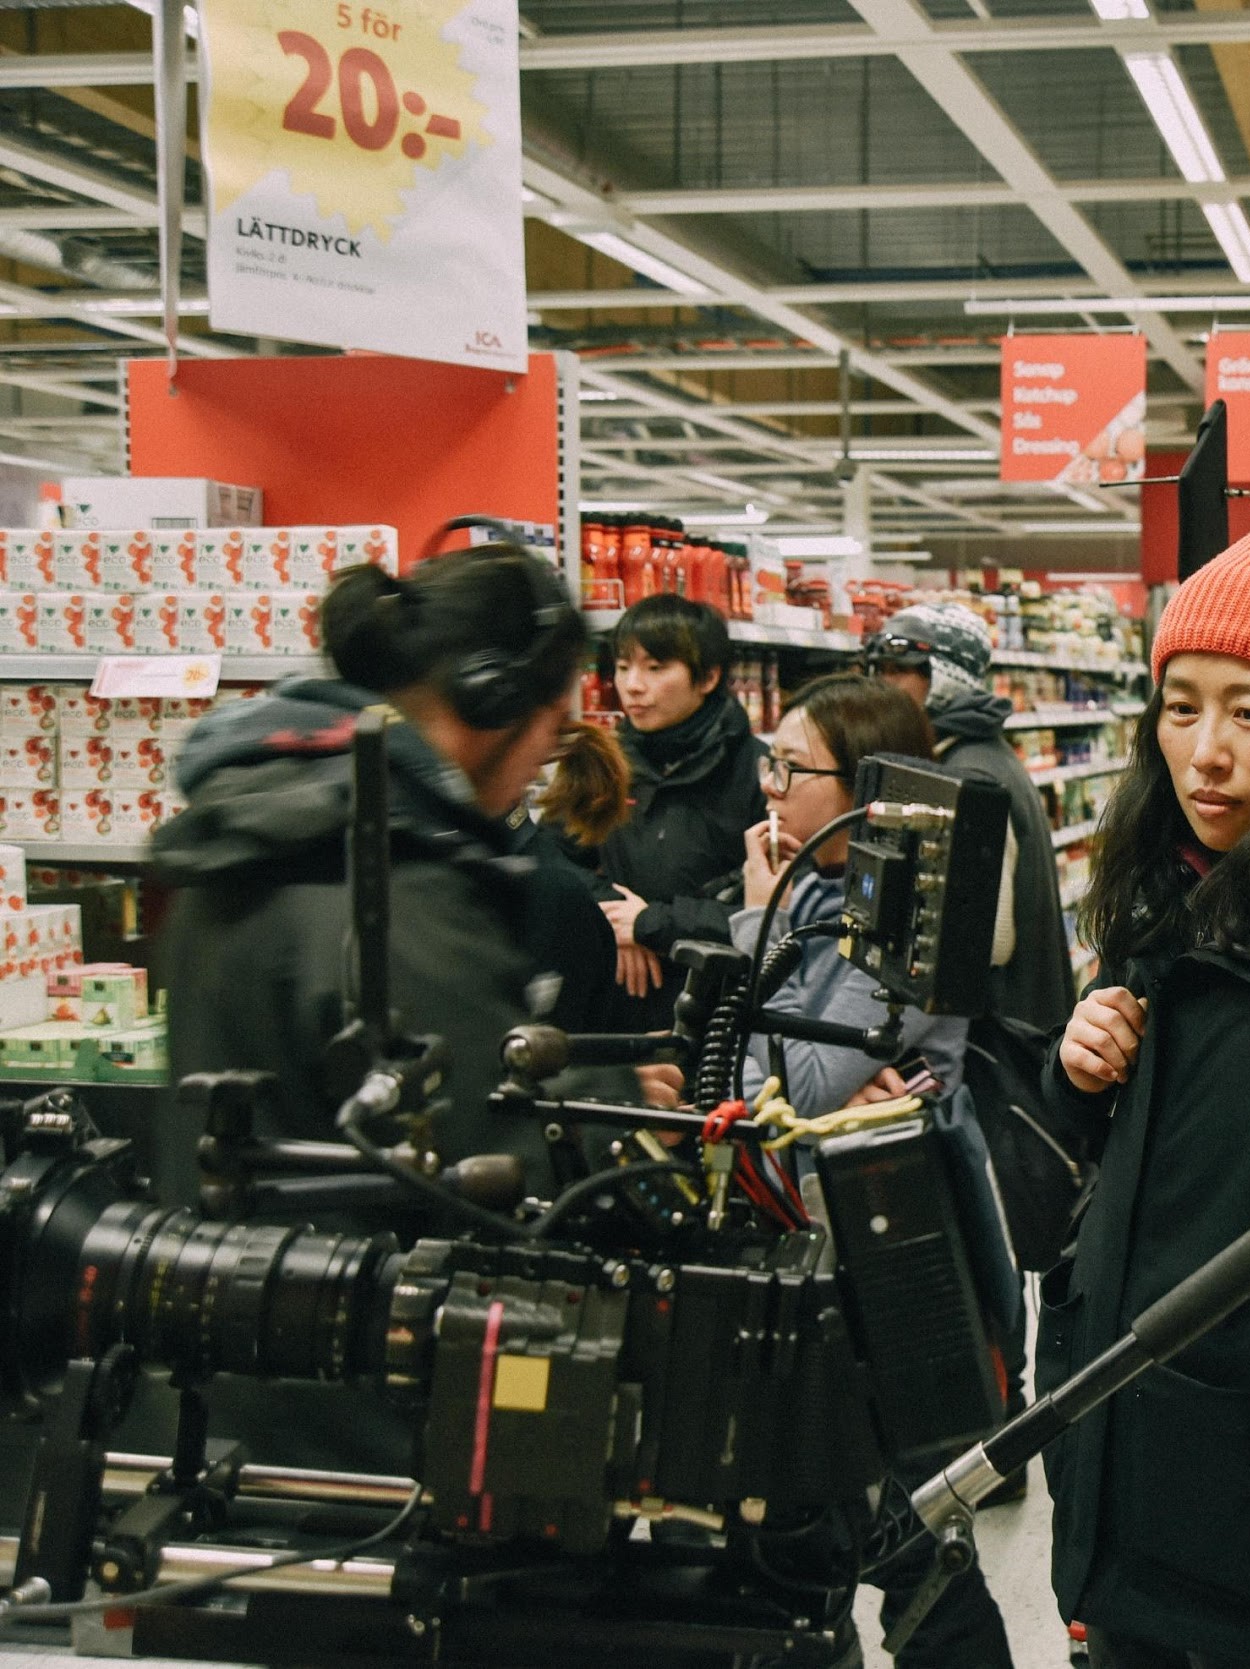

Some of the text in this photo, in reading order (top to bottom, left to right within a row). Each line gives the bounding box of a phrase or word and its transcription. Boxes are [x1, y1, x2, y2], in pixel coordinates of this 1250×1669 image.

[337, 3, 403, 41] 5 för
[277, 30, 461, 161] 20:-
[237, 216, 361, 258] LÄTTDRYCK
